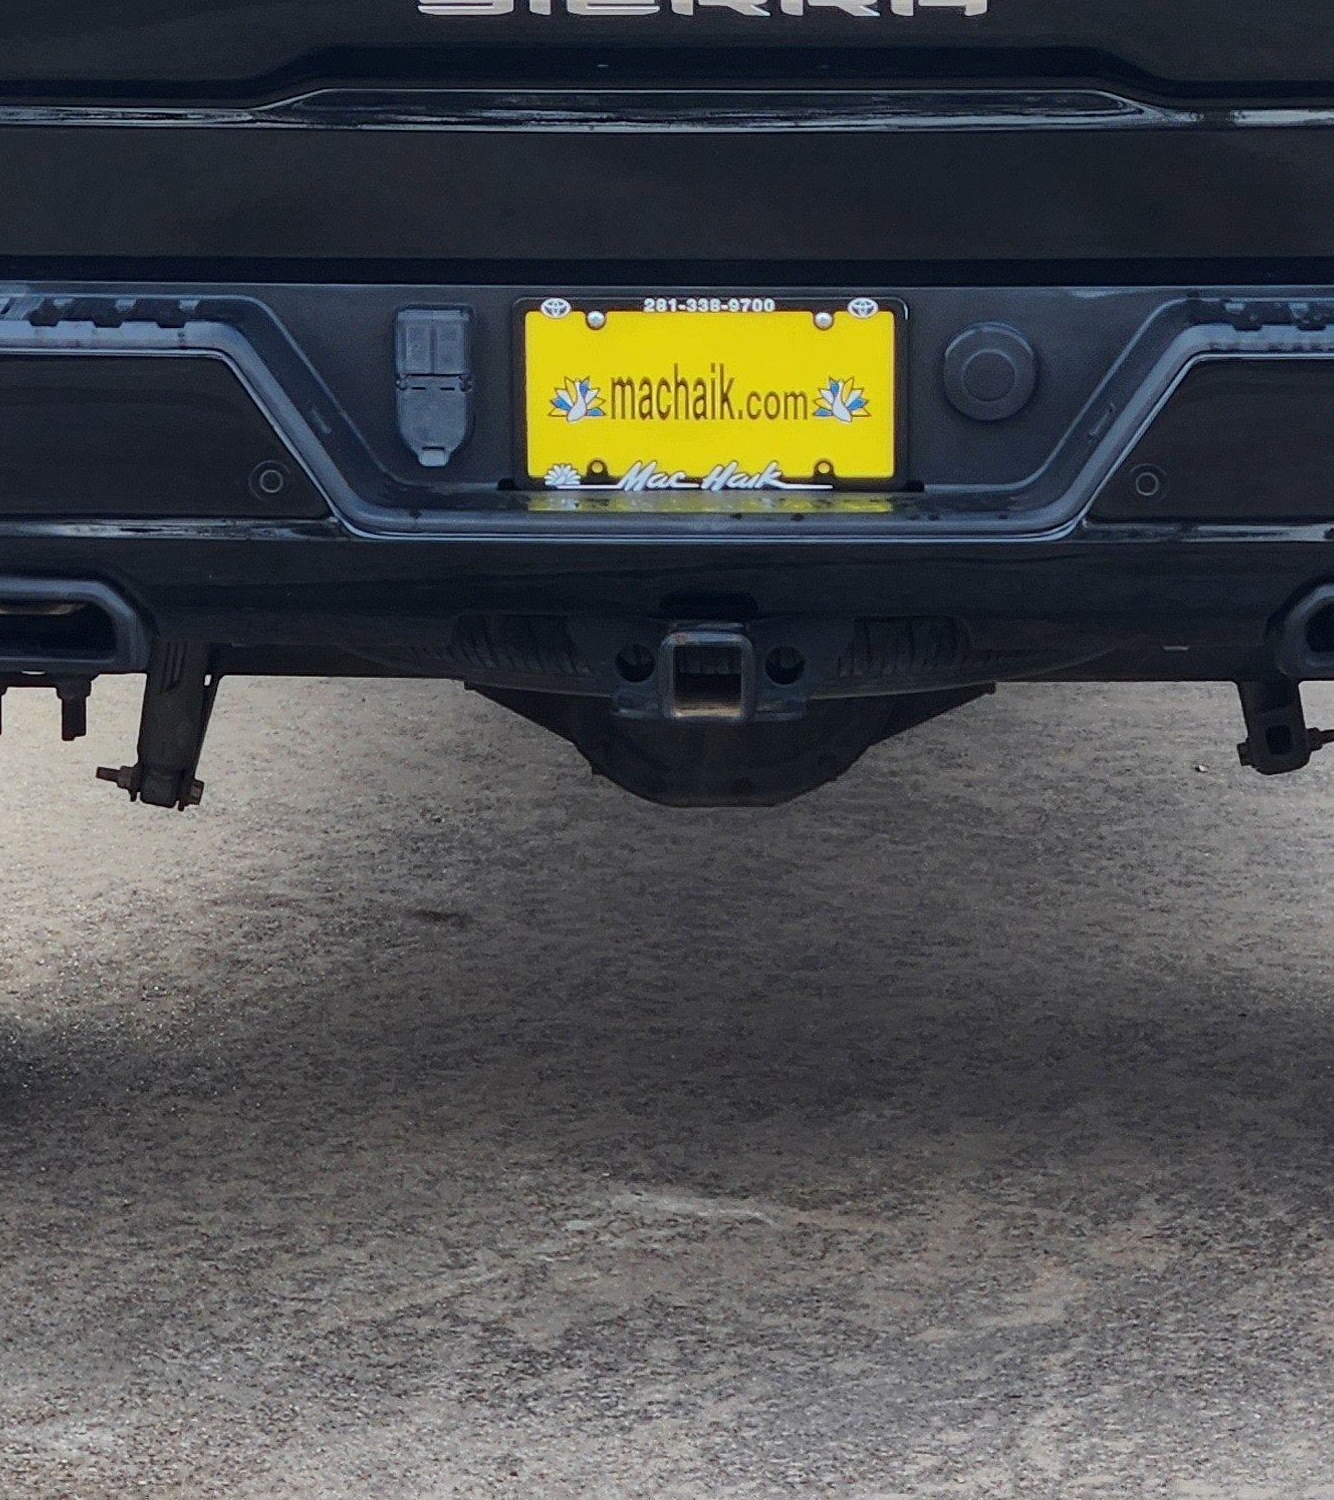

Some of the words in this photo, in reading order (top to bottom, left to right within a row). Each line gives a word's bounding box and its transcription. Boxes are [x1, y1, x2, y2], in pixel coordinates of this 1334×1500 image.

[643, 297, 776, 313] 281-338-9700
[611, 362, 809, 421] machaik.com
[613, 460, 699, 492] Mac
[700, 460, 795, 492] Haik
